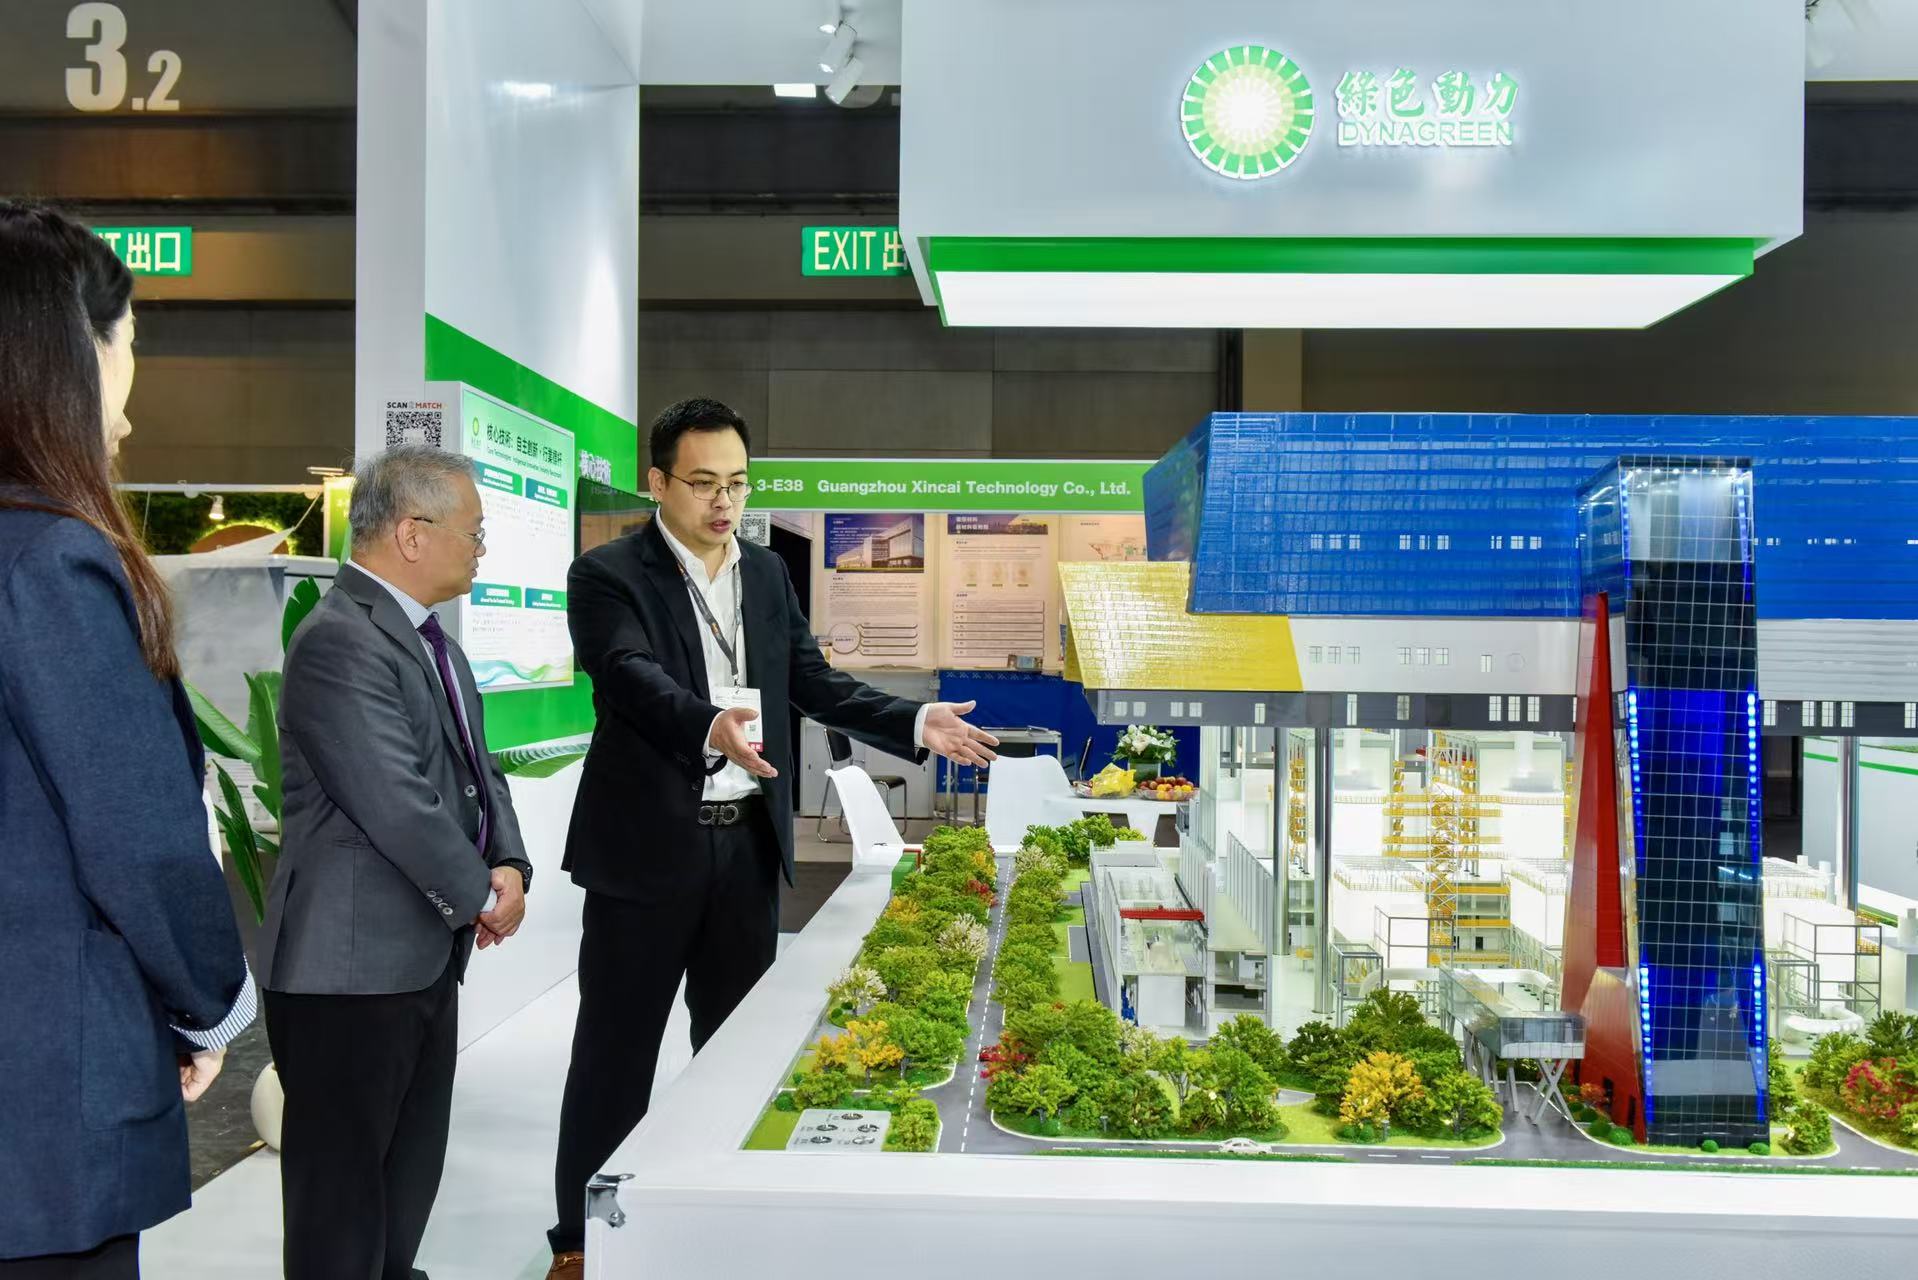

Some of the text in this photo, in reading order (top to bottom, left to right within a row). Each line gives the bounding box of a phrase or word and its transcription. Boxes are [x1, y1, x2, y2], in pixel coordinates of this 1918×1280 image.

[65, 2, 182, 112] 3.2
[1335, 68, 1519, 119] 綠色動力
[1338, 120, 1515, 146] DYNAGREEN
[126, 231, 181, 271] 出口
[814, 231, 877, 270] EXIT
[756, 479, 1131, 497] 3-E38 Guangzhou Xincai Technology Co., Ltd.
